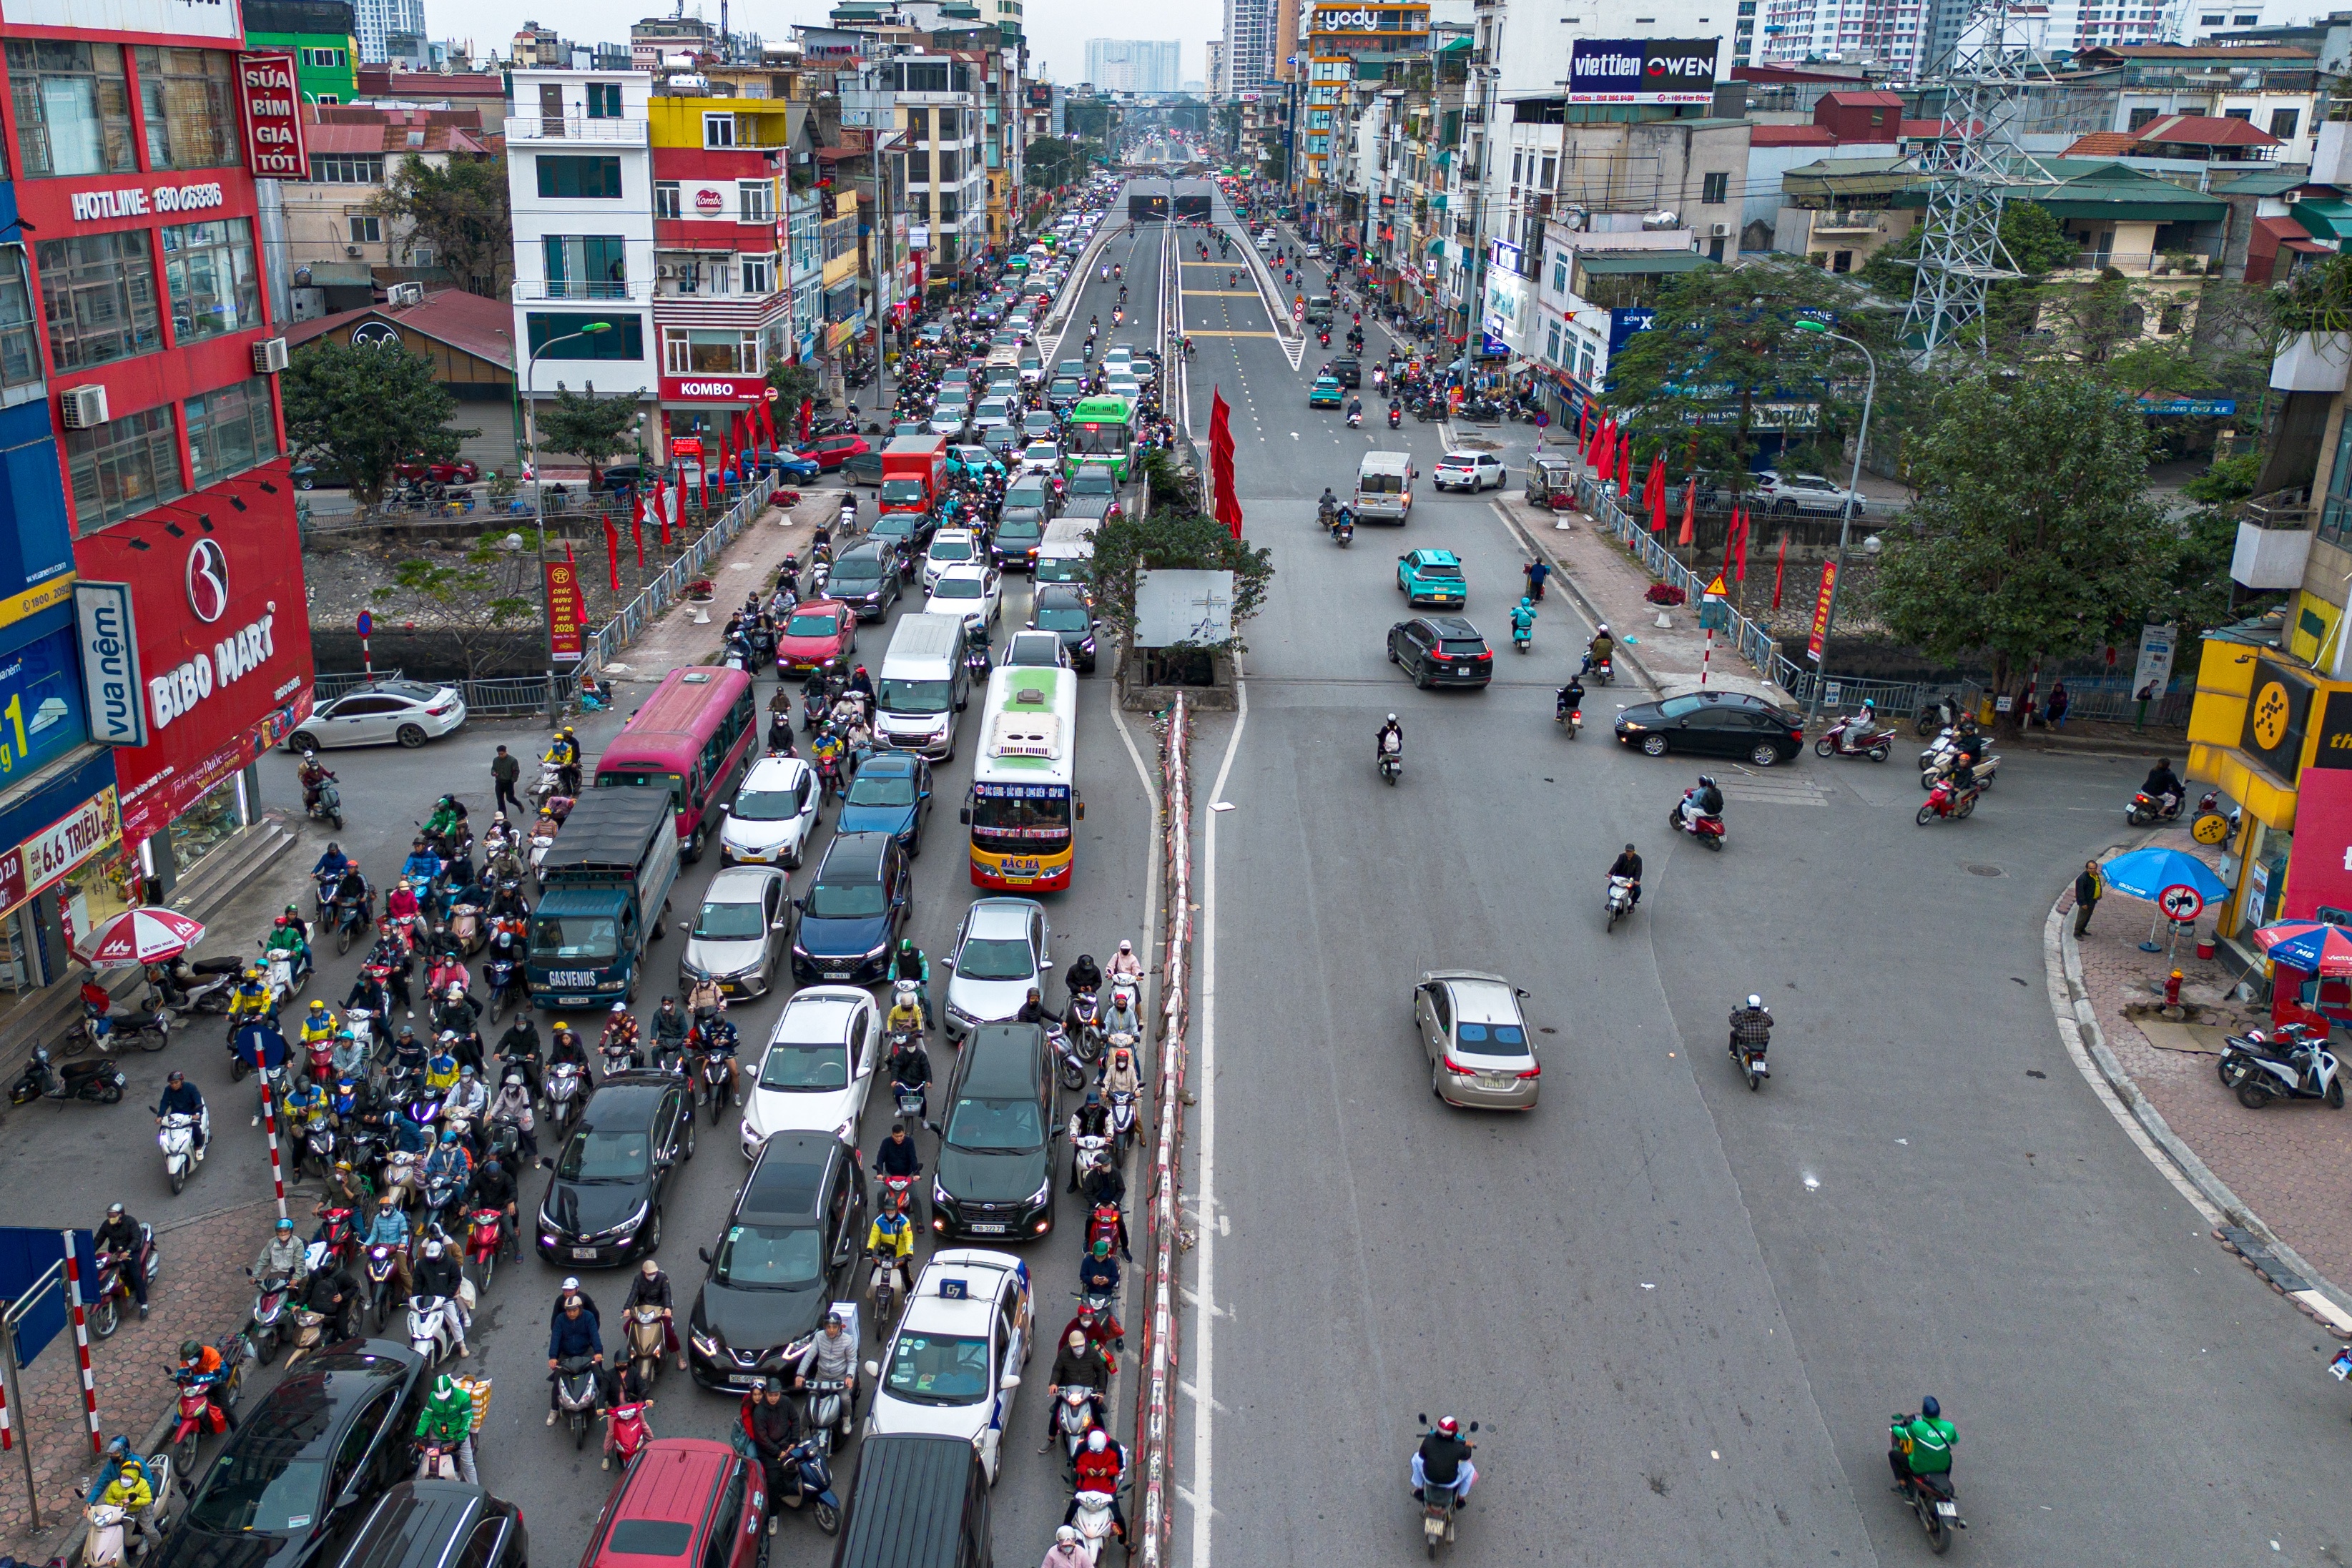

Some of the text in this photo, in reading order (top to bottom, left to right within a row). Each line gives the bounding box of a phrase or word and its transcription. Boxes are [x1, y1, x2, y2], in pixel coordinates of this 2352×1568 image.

[1326, 6, 1378, 31] yody
[246, 65, 290, 88] SỮA
[1575, 54, 1713, 77] viettien OWEN
[252, 92, 291, 116] BỈM
[257, 122, 294, 143] GIÁ
[257, 146, 296, 171] TỐT
[71, 188, 150, 220] HOTLINE:
[681, 383, 733, 395] KOMBO
[31, 584, 70, 608] 1800 2092
[554, 623, 574, 632] 2026
[92, 607, 124, 676] nệm
[149, 614, 274, 729] BIBO MART
[103, 682, 126, 736] vua
[43, 834, 65, 872] 6.6
[65, 810, 100, 857] TRIỆU
[31, 847, 40, 864] GIÁ
[1001, 854, 1023, 868] BẮC
[4, 857, 16, 879] 2.0
[2296, 948, 2314, 959] MB
[946, 1283, 960, 1298] G7
